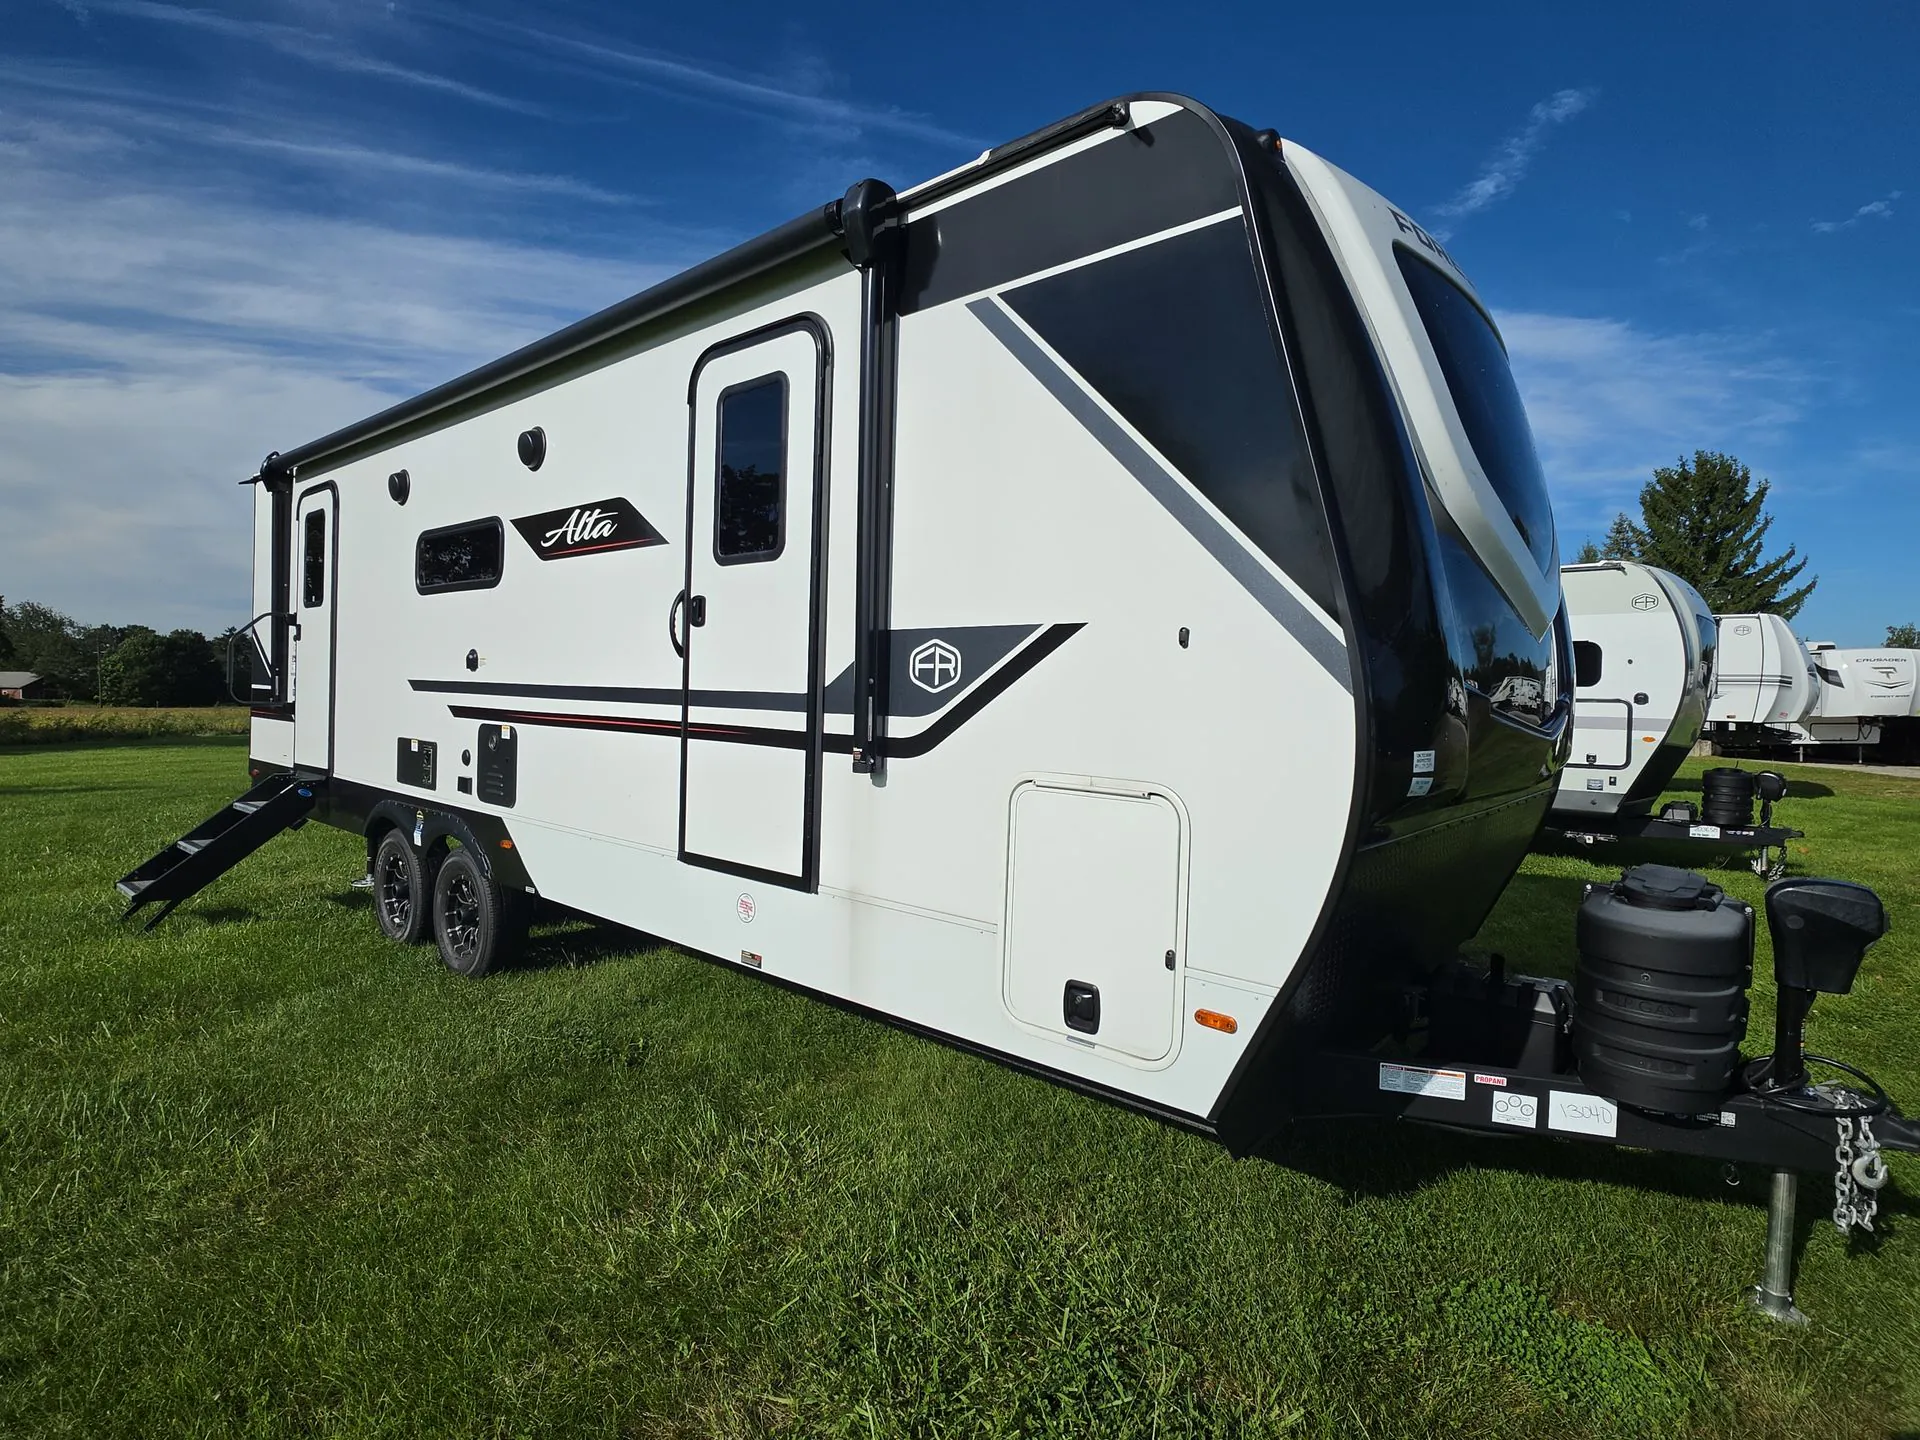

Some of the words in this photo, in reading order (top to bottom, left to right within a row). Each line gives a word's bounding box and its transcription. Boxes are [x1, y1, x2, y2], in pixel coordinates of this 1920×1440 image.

[540, 508, 619, 548] Alta
[1475, 1075, 1506, 1086] PROPANE
[1560, 1102, 1614, 1125] 13040
